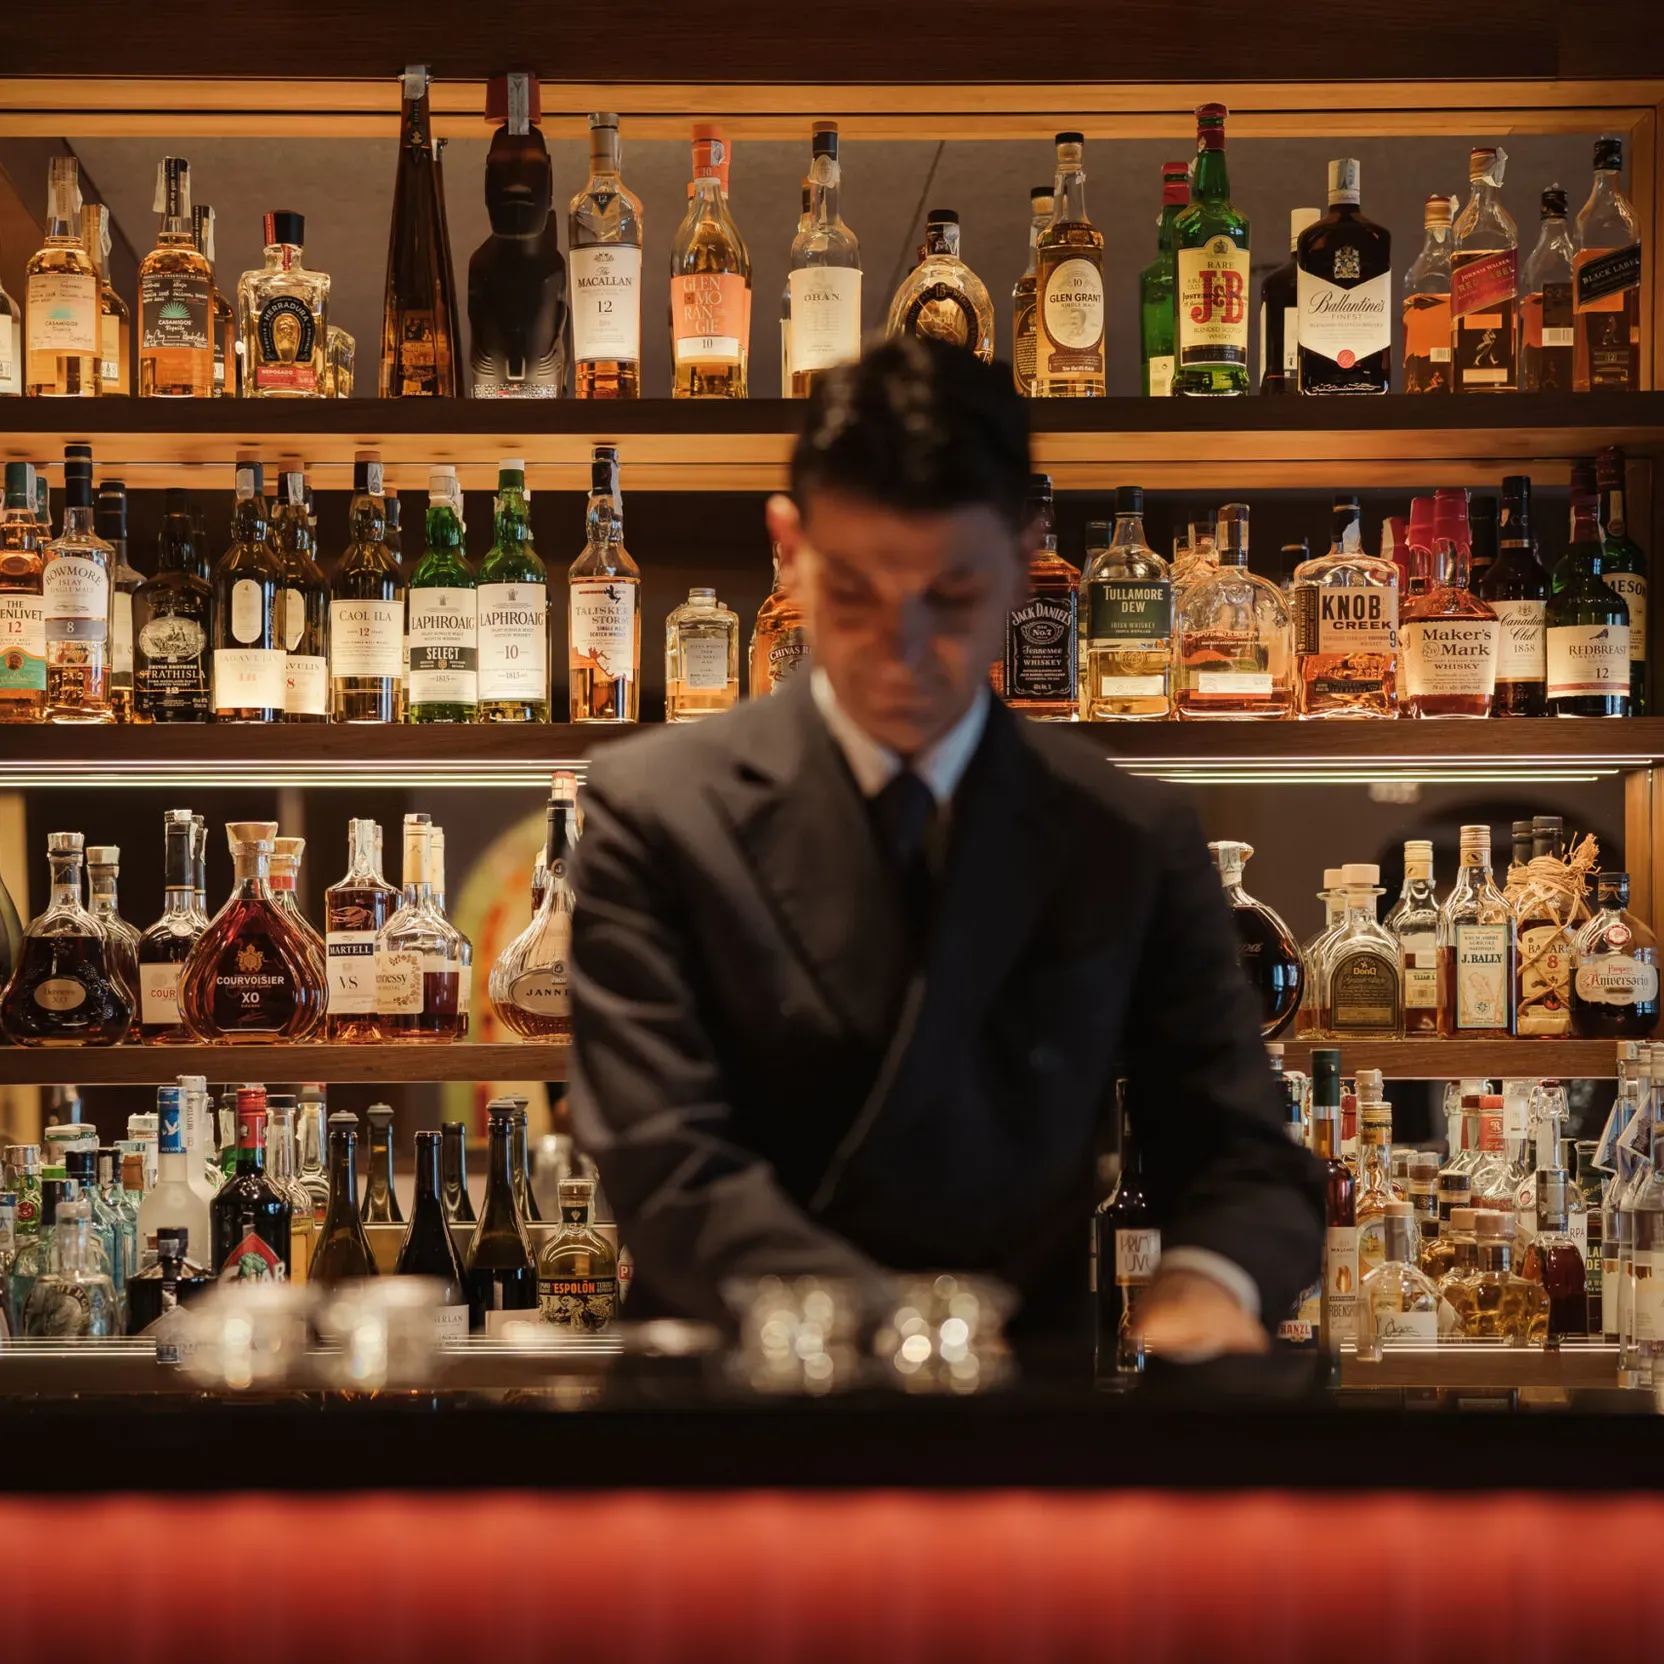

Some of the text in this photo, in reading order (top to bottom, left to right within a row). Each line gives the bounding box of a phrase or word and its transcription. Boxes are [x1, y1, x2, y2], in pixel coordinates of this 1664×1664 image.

[1207, 261, 1234, 269] RARE
[1582, 258, 1641, 285] BLACK LABEL
[578, 277, 632, 288] MACALLAN
[683, 276, 720, 291] GLEN
[1073, 278, 1083, 287] 10
[695, 291, 722, 305] MO
[804, 293, 840, 302] OBAN
[1049, 293, 1101, 303] GLEN GRANT
[1308, 290, 1386, 315] Ballantine's
[263, 301, 310, 323] HERRADURA
[598, 300, 613, 313] 12
[684, 305, 713, 321] RAN
[696, 319, 720, 335] GIE
[702, 338, 713, 349] 10
[46, 566, 102, 587] BOWMORE
[1103, 585, 1164, 600] TULLAMORE
[576, 606, 629, 616] TALISKER
[1121, 601, 1146, 613] DEW
[1322, 595, 1380, 620] KNOB
[0, 608, 44, 621] ENLIVET
[340, 610, 392, 622] CAOL ILA
[480, 611, 544, 627] LAPHROAIG
[591, 615, 629, 625] STORM
[1011, 606, 1036, 626] JACK
[8, 621, 22, 633] 12
[67, 622, 75, 633] 8
[412, 615, 474, 630] LAPHROAIG
[1332, 621, 1393, 630] CREEK
[359, 627, 370, 636] 12
[1422, 629, 1492, 641] Maker's
[1510, 627, 1539, 641] Club
[1389, 630, 1397, 648] 9
[426, 647, 460, 660] SELECT
[505, 644, 519, 660] 10
[769, 646, 800, 661] CHIVAS
[1022, 646, 1063, 655] Tennessee
[1441, 644, 1490, 656] Mark
[1514, 644, 1535, 653] 1858
[1569, 644, 1627, 655] REDBREAST
[139, 670, 206, 679] STRATHISLA
[1595, 667, 1609, 679] 12
[287, 678, 295, 689] 8
[329, 946, 371, 955] MARTELL
[1547, 955, 1559, 969] 8
[1353, 967, 1377, 975] DonQ
[216, 976, 285, 985] COURVOISIER
[338, 975, 359, 989] VS
[241, 992, 260, 1003] XO
